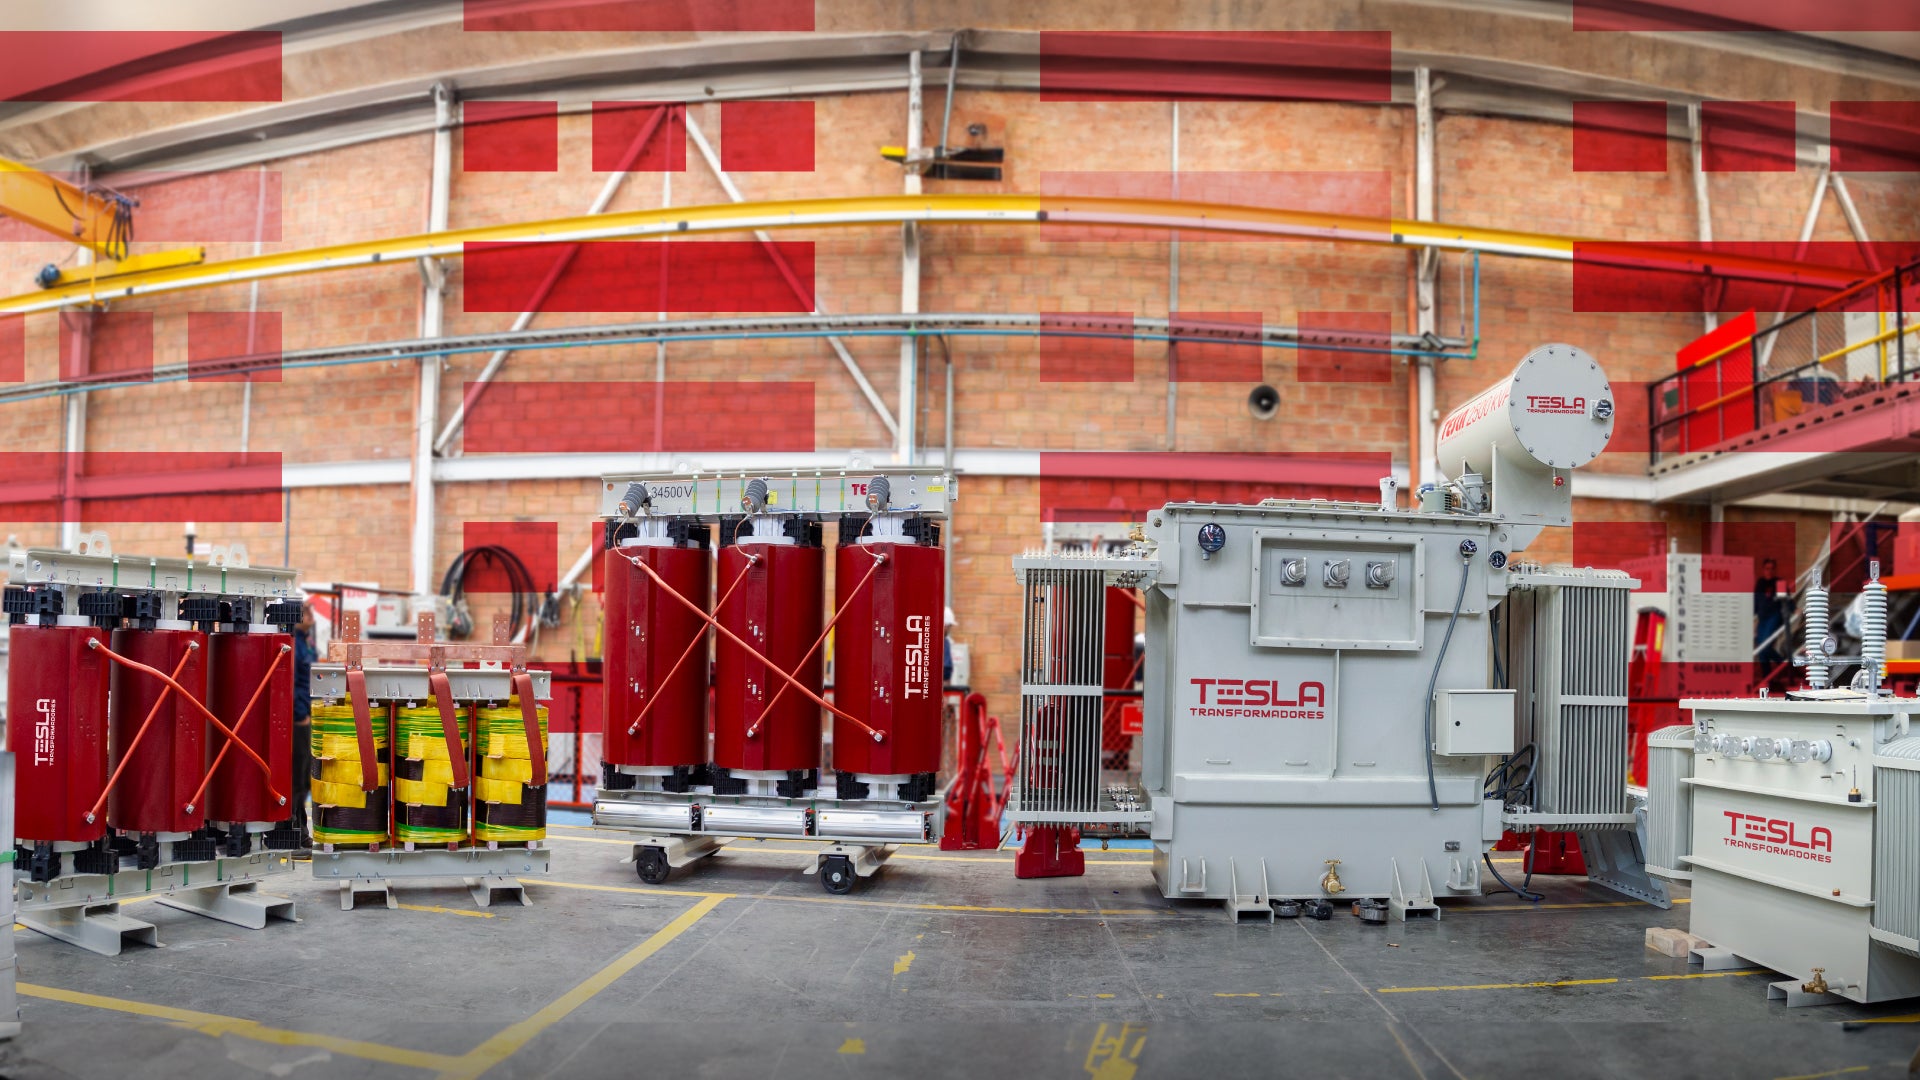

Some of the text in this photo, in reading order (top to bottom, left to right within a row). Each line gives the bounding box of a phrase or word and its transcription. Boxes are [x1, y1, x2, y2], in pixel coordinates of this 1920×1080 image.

[1526, 395, 1586, 409] TESLA
[651, 486, 683, 498] 34500
[904, 615, 923, 699] TESLA
[922, 615, 931, 699] TRANSFORMADORES
[1190, 678, 1325, 708] TESLA
[1189, 707, 1325, 720] TRANSFORMADORES
[34, 698, 51, 767] TESLA
[49, 699, 57, 767] TRANSFORMADORES
[1723, 810, 1832, 853] TESLA
[1723, 837, 1832, 864] TRANSFORMADORES
